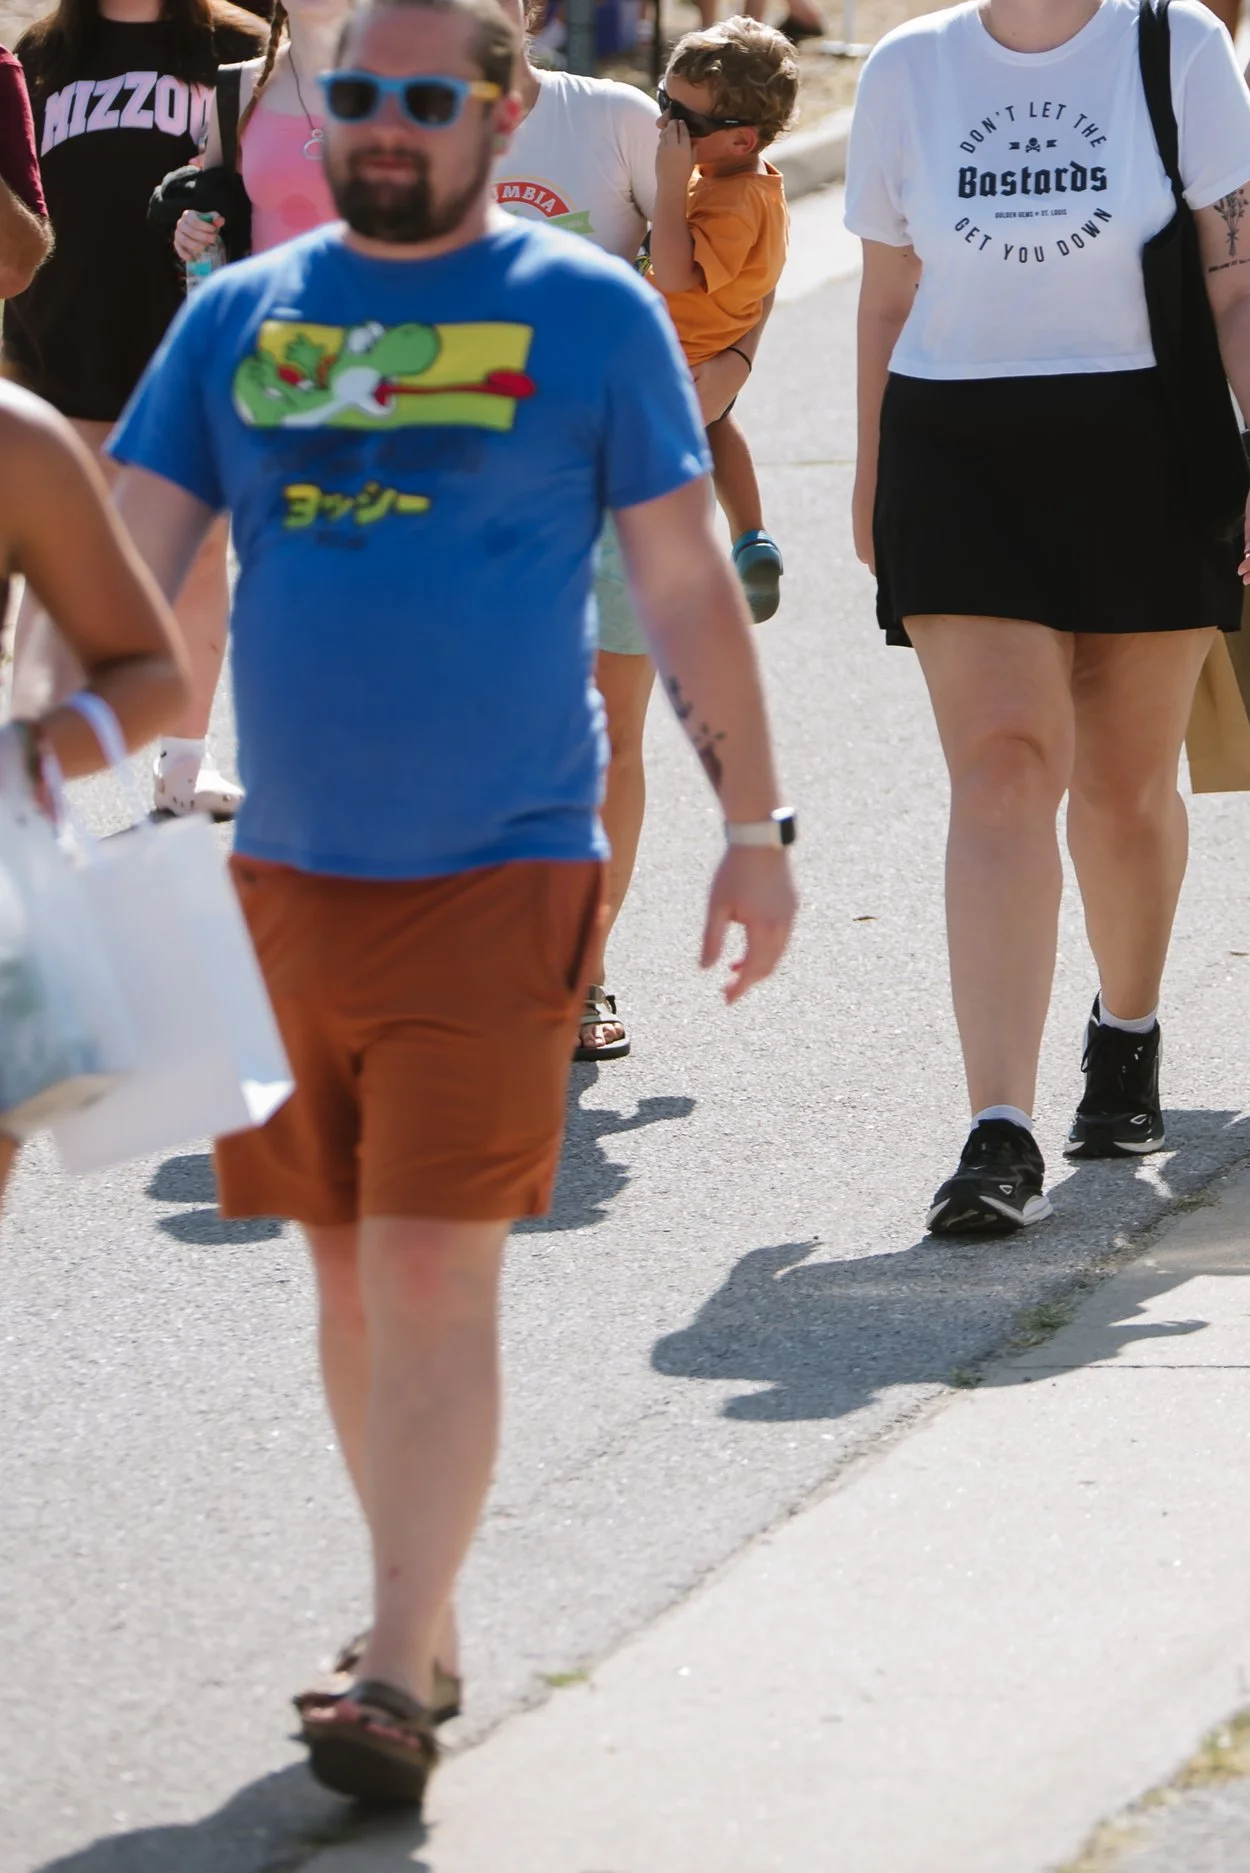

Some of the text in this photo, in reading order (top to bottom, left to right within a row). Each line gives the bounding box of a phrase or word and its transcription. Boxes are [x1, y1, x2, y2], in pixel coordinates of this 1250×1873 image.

[959, 101, 1107, 154] DON'T LET THE
[958, 160, 1107, 199] Bastards
[954, 207, 1113, 264] GET YOU DOWN
